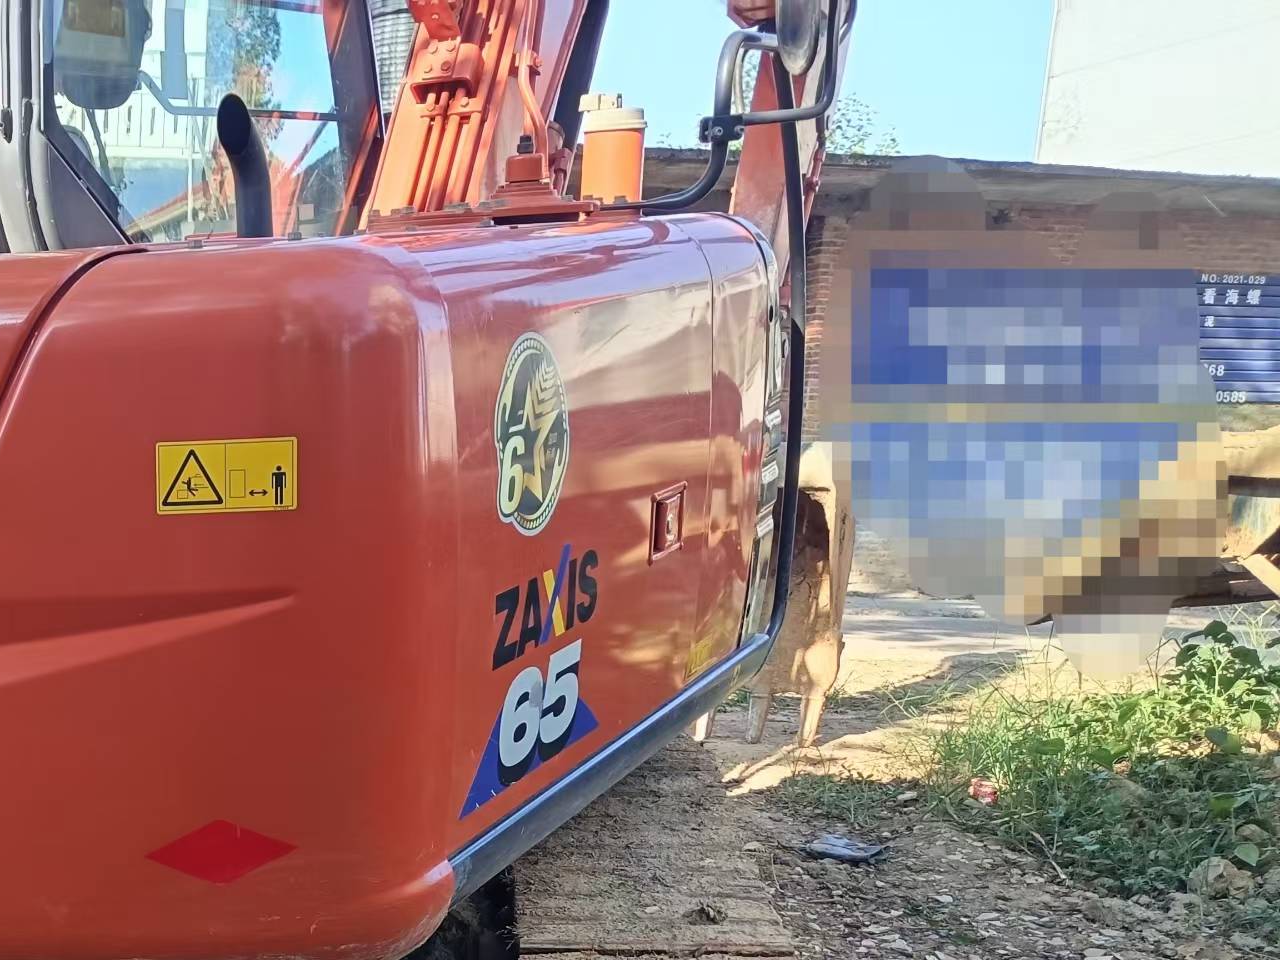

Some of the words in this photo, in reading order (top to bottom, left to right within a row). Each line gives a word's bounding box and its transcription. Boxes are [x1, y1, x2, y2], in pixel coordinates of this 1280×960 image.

[1223, 274, 1266, 285] 2021-029
[1204, 363, 1225, 376] 68
[492, 544, 598, 671] ZAXIS
[499, 639, 583, 768] 65
